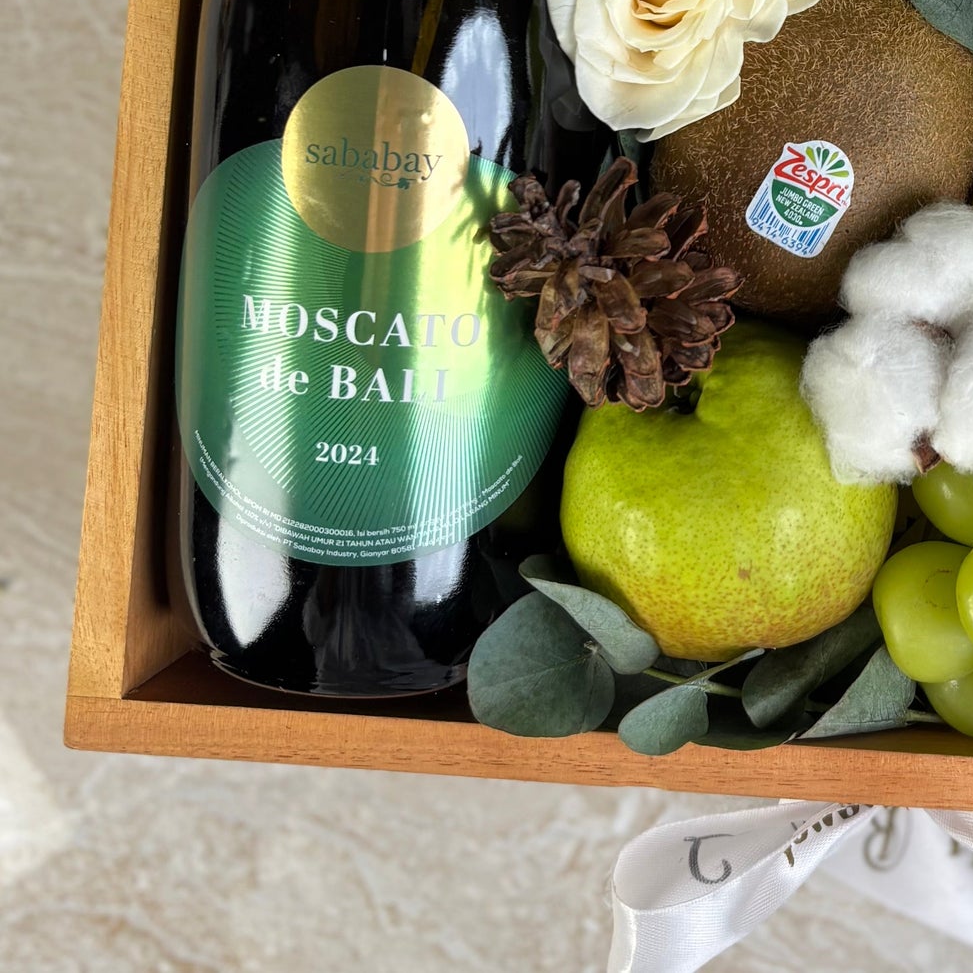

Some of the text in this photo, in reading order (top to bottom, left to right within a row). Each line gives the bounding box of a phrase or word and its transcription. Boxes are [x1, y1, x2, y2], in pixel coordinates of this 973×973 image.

[305, 137, 444, 180] sababay
[774, 145, 849, 207] Zespri
[776, 194, 819, 223] NEW ZEALAND
[780, 187, 825, 215] JUMBO GREEN
[752, 218, 809, 256] 9414 6394
[241, 294, 481, 347] MOSCATO
[260, 354, 449, 403] de BALI
[315, 442, 380, 466] 2024
[481, 474, 507, 497] Moscato
[270, 512, 282, 522] MD
[356, 529, 365, 537] Isi
[366, 527, 390, 537] bersih
[391, 525, 406, 534] 750
[283, 538, 293, 546] PT
[293, 541, 325, 556] Sababay
[360, 549, 390, 558] Gianyar
[390, 544, 416, 555] 80581
[311, 535, 335, 546] UMUR
[335, 539, 344, 547] 21
[345, 539, 374, 547] TAHUN
[375, 536, 396, 546] ATAU
